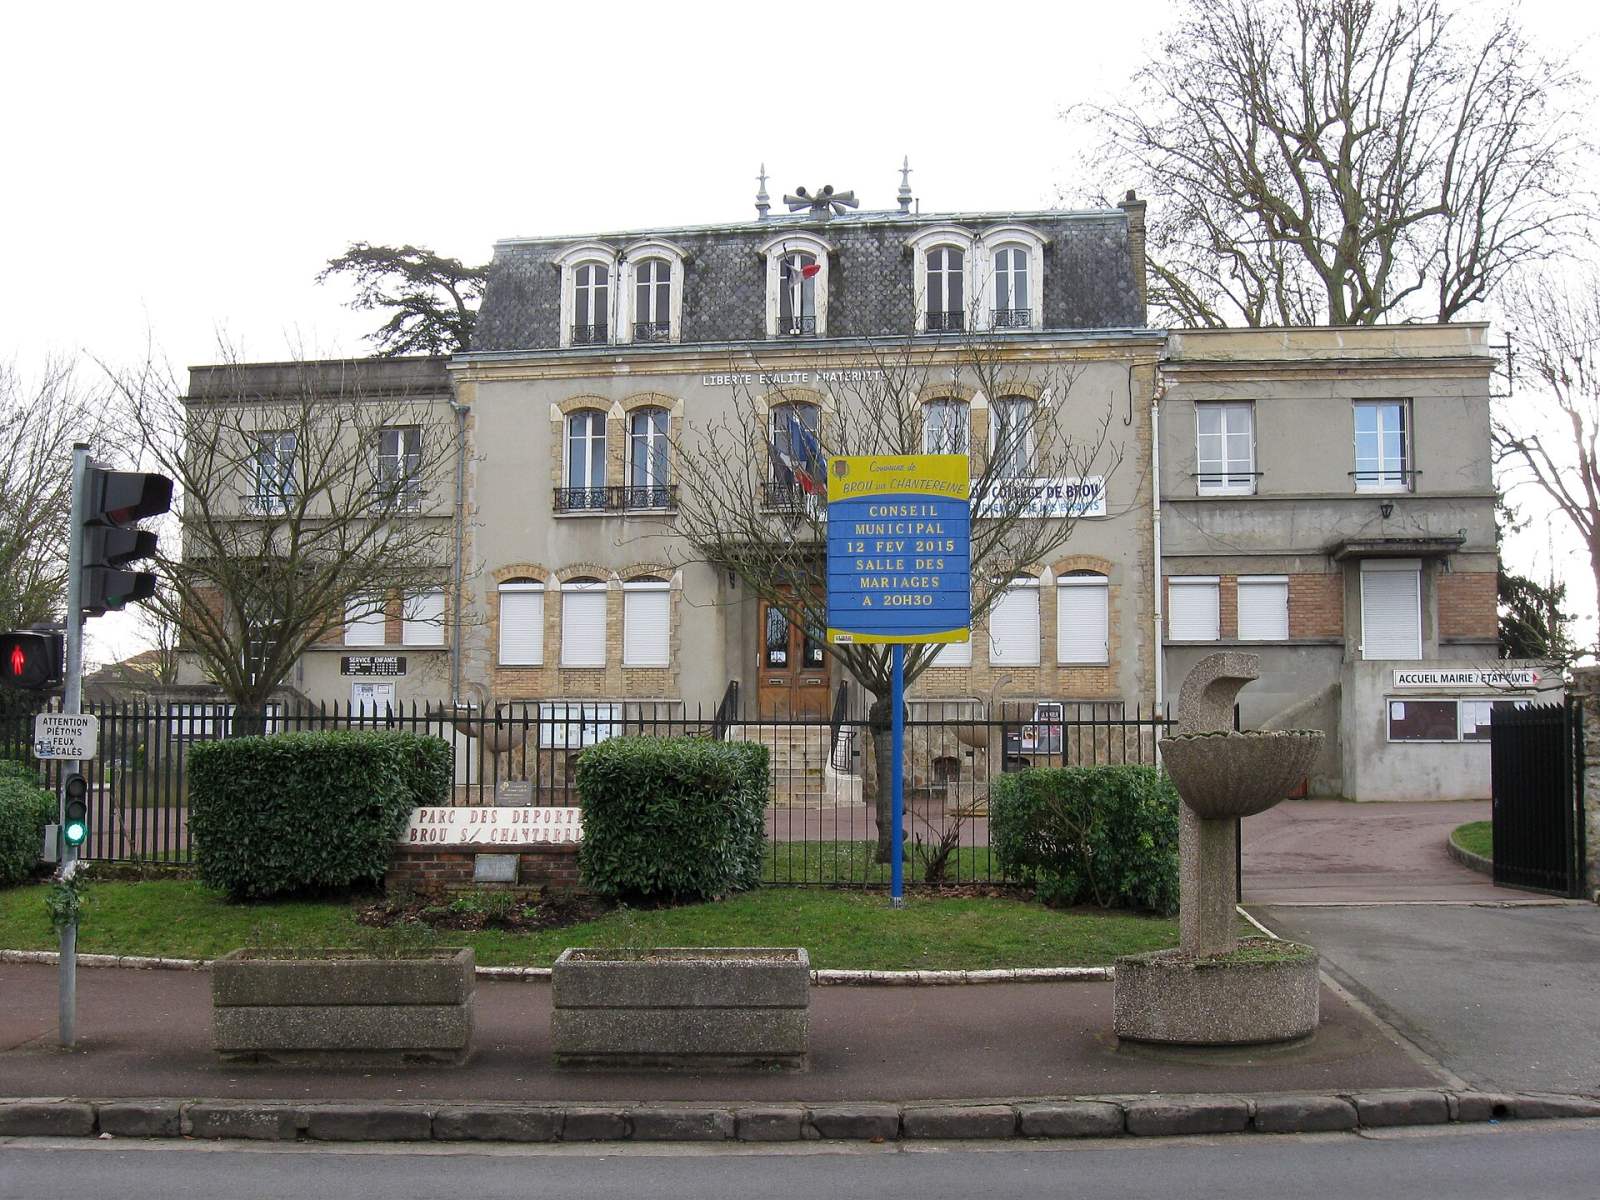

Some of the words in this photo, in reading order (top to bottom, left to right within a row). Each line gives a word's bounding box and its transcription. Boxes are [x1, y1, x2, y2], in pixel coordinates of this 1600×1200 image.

[703, 374, 752, 386] LIBERTE
[869, 460, 905, 473] Commune
[908, 462, 918, 472] de
[843, 480, 873, 494] BROU
[889, 478, 966, 494] CHANTEREINE
[1046, 485, 1063, 498] DE
[1066, 484, 1100, 498] BROU
[869, 505, 938, 517] CONSEIL
[855, 523, 945, 535] MUNICIPAL
[847, 542, 865, 553] 12
[876, 541, 905, 553] FEV
[916, 540, 954, 552] 2015
[856, 559, 905, 570] SALLE
[916, 559, 944, 570] DES
[860, 577, 940, 588] MARIAGES
[863, 595, 872, 606] A
[884, 595, 933, 606] 20H30
[1398, 674, 1438, 684] ACCUEIL
[1440, 673, 1473, 683] MAIRIE
[43, 718, 88, 727] ATTENTION
[46, 726, 83, 736] PIÉTONS
[53, 737, 75, 746] FEUX
[46, 745, 83, 756] ÉCALÉS
[419, 809, 456, 824] PARC
[469, 809, 498, 824] DES
[410, 828, 448, 842] BROU
[490, 827, 583, 842] CHANTEREI
